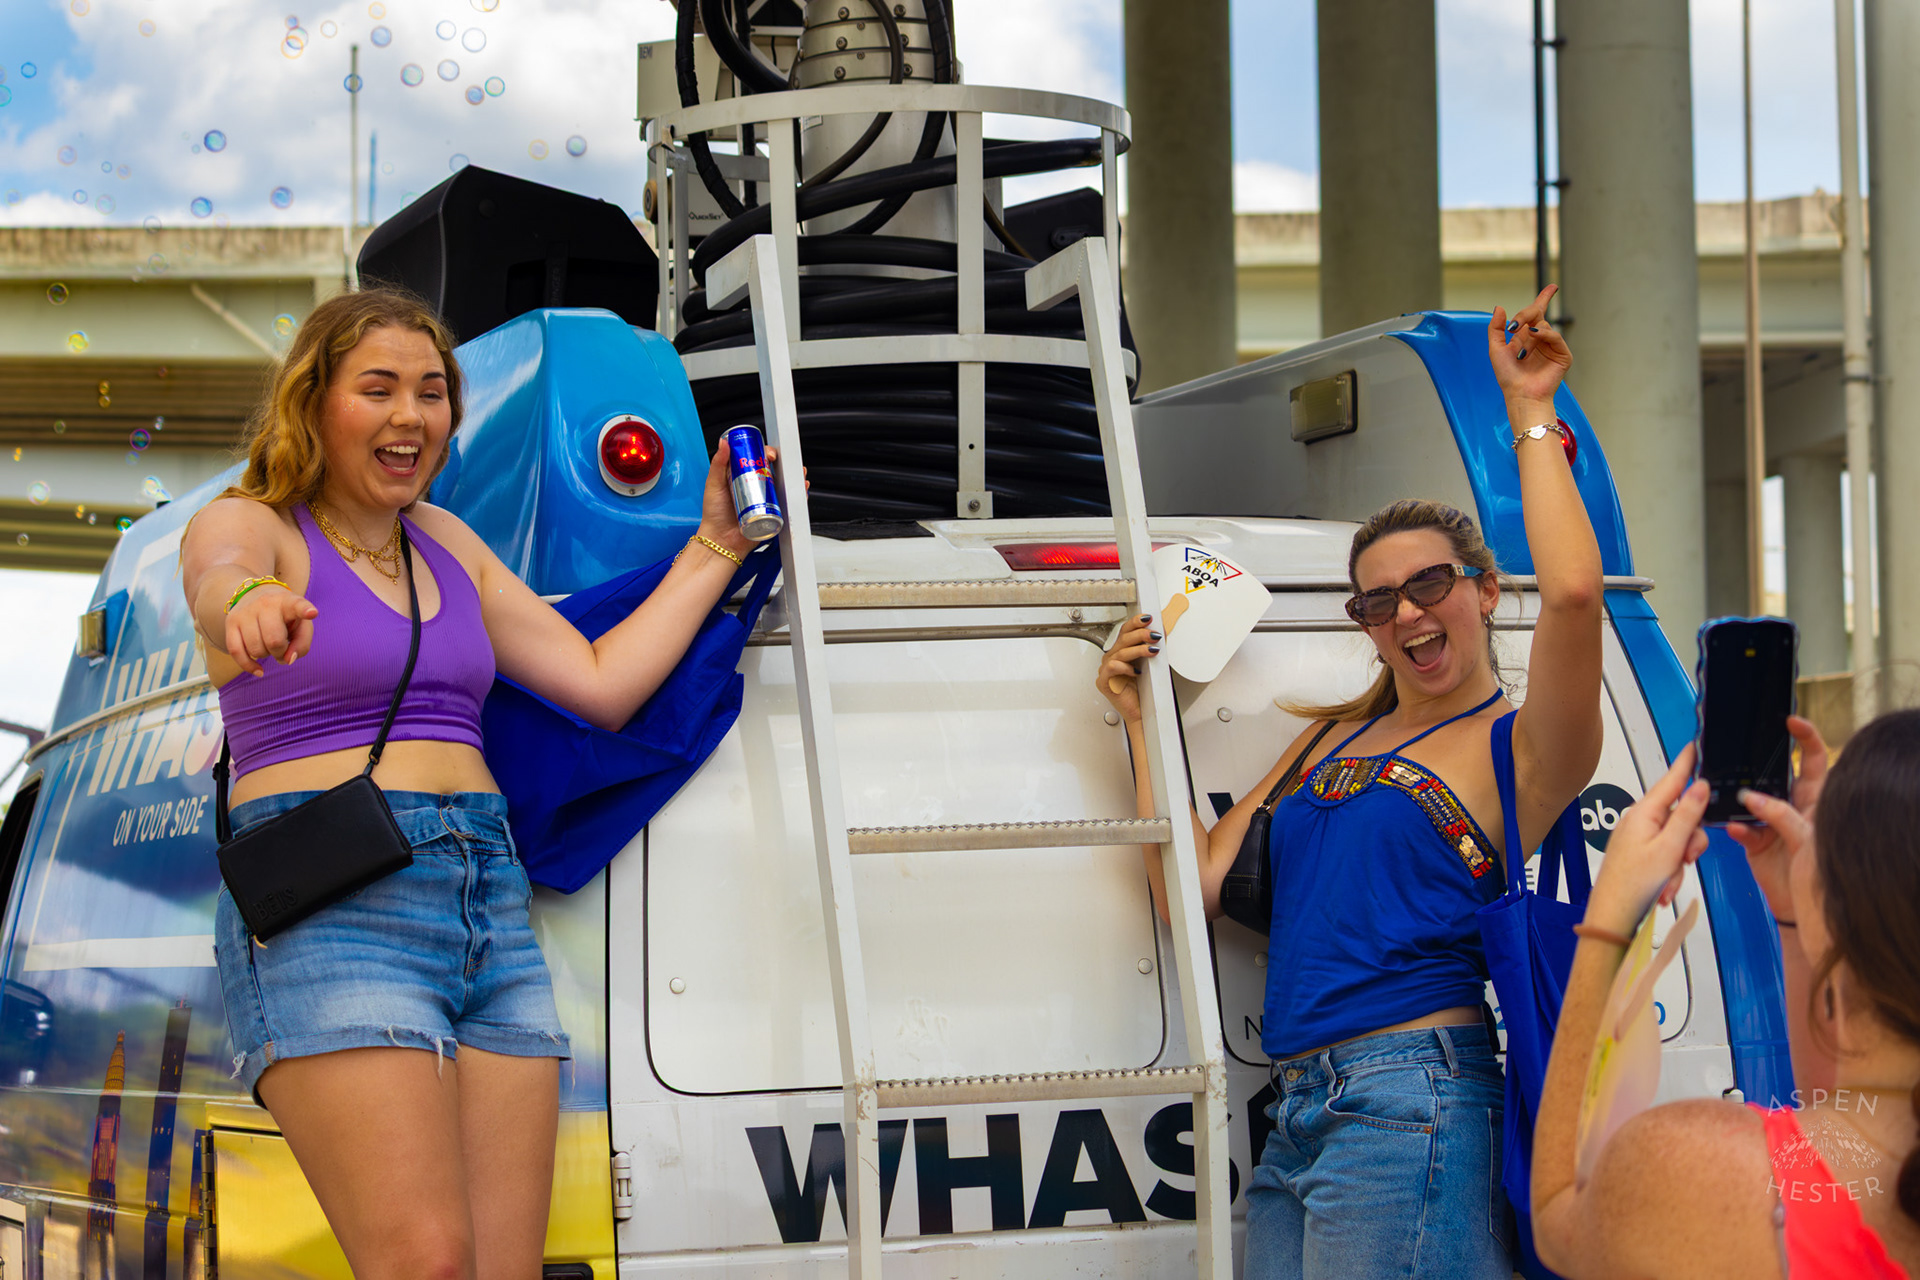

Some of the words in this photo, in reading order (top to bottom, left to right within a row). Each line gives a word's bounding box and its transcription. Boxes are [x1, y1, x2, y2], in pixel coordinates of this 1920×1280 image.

[739, 457, 764, 469] Red
[1181, 565, 1219, 587] ABOA
[113, 808, 137, 847] ON
[133, 801, 172, 843] YOUR
[169, 794, 209, 838] SIDE
